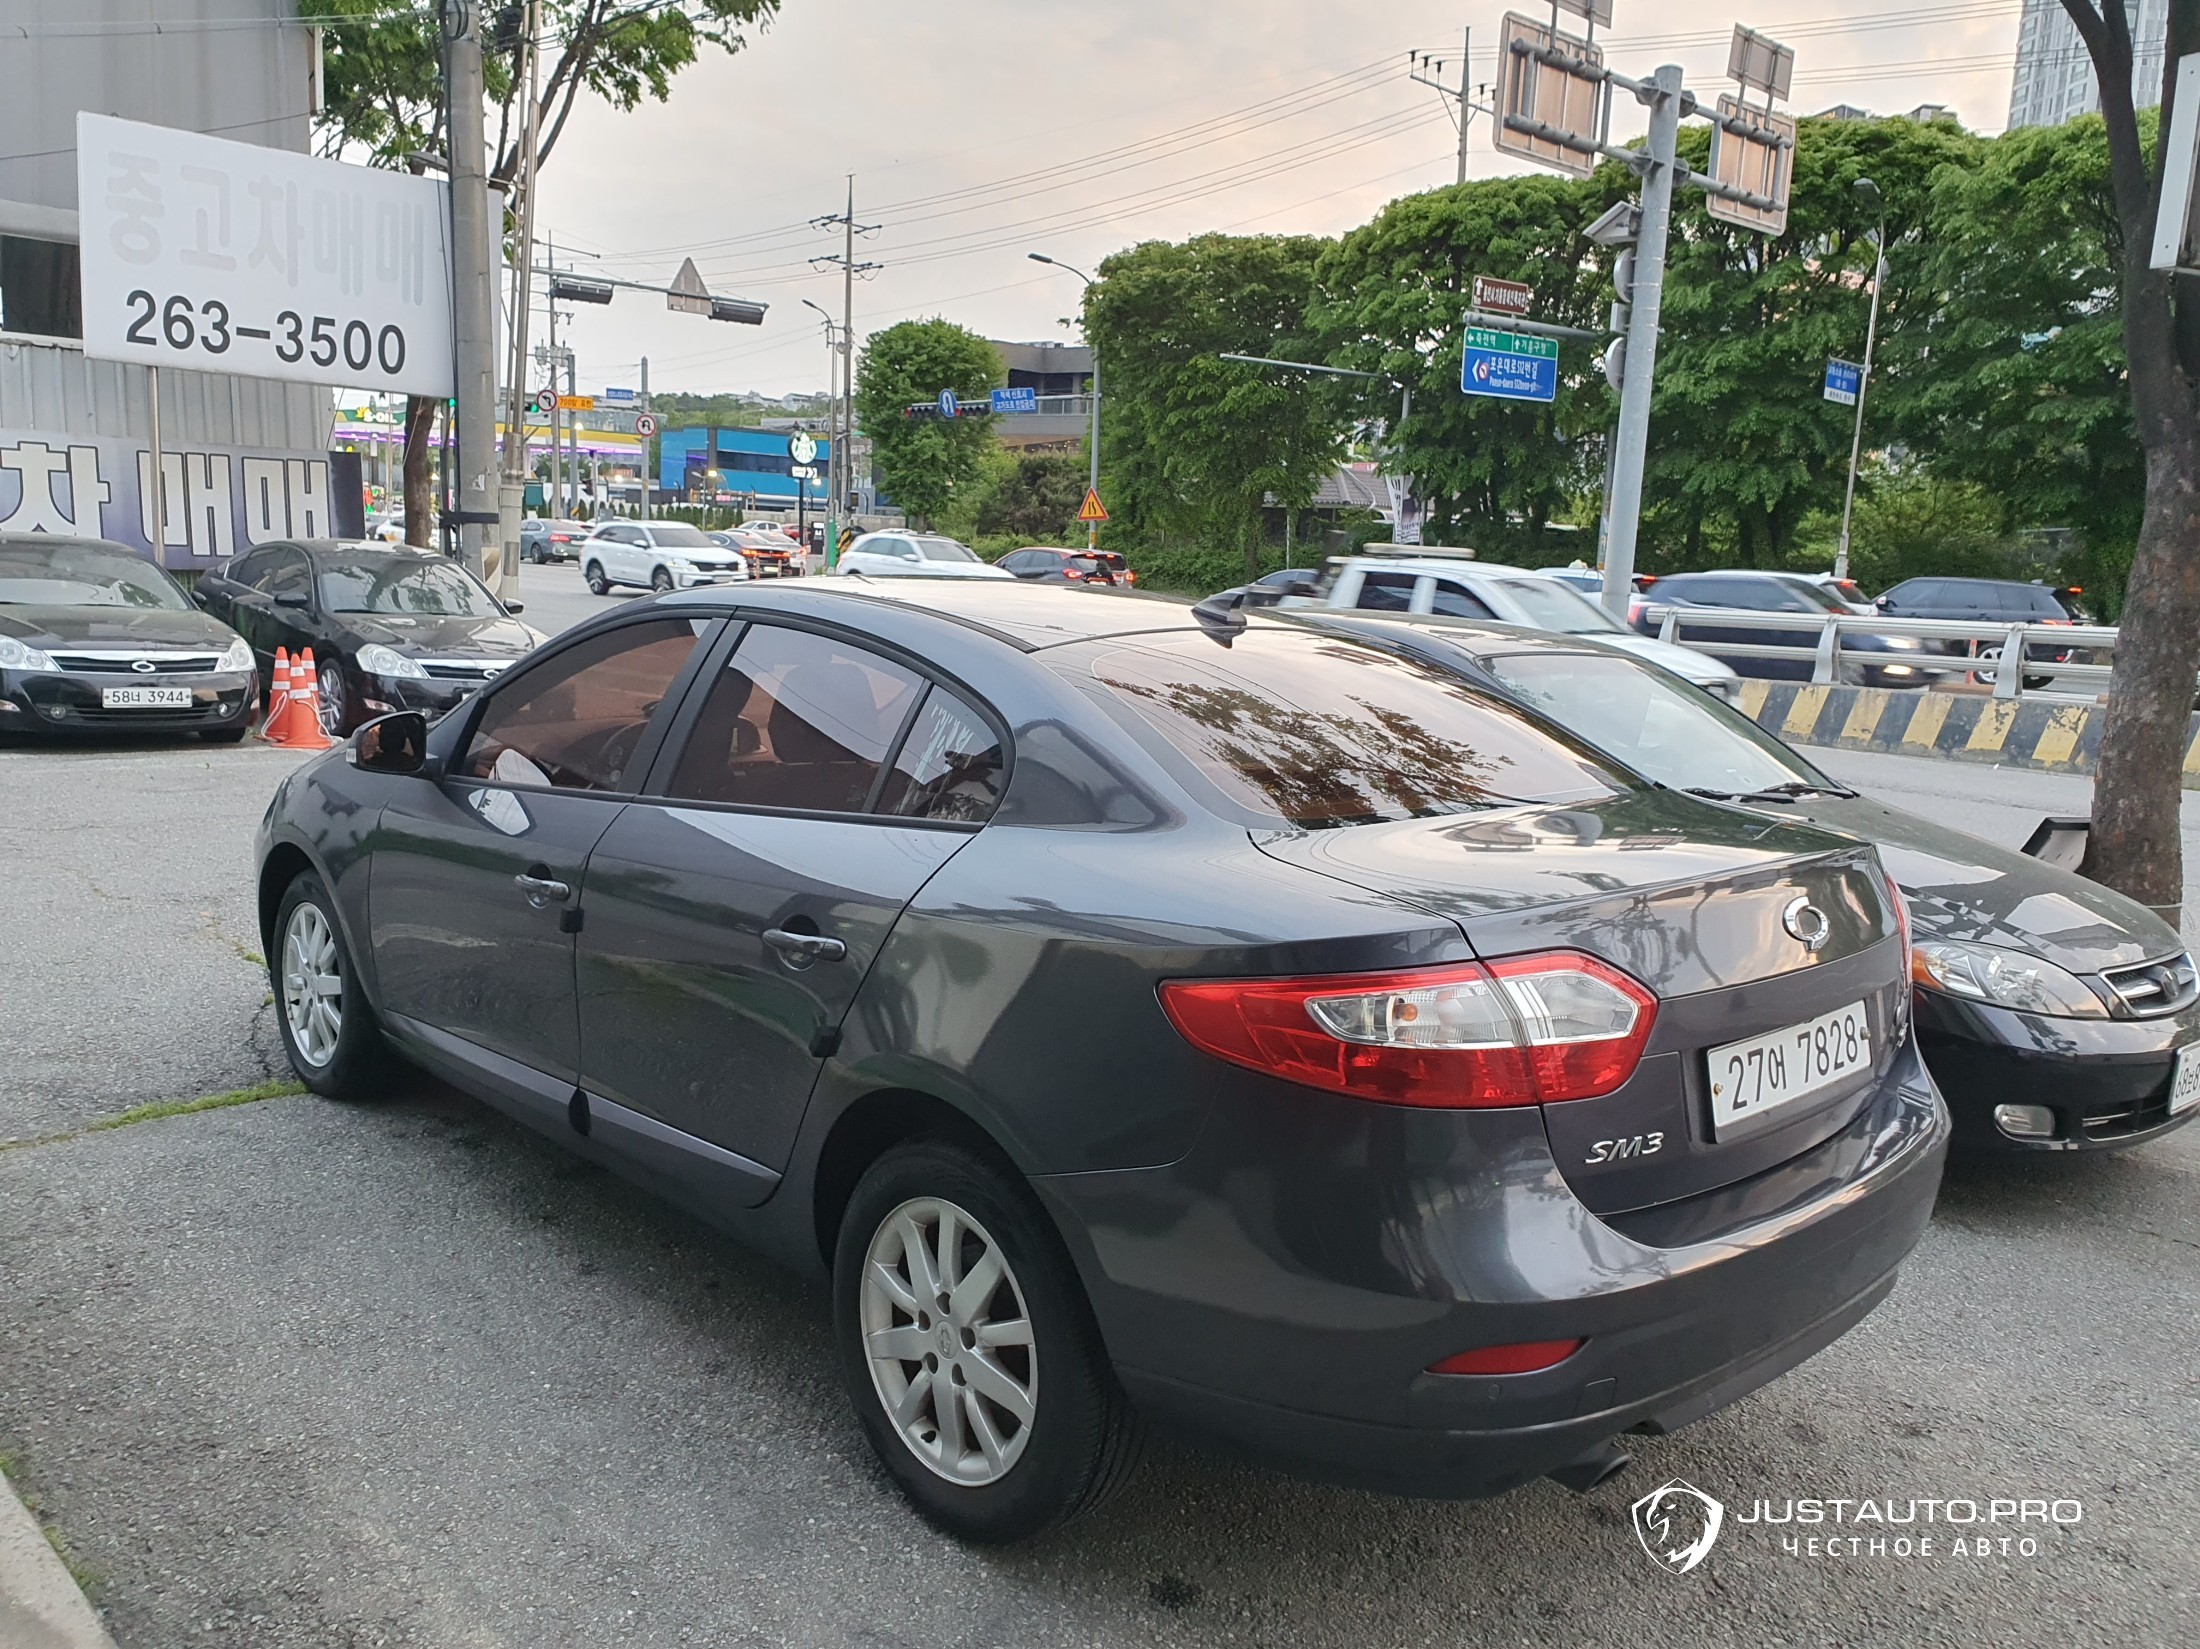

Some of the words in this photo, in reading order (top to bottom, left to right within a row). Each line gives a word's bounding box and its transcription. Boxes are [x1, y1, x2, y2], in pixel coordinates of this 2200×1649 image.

[105, 151, 424, 306] 중고차매매
[126, 290, 406, 374] 263-3500
[112, 690, 140, 703] 58너
[147, 690, 184, 703] 3944
[1728, 1044, 1787, 1111] 27어
[1797, 1014, 1858, 1084] 7828
[1585, 1132, 1664, 1164] SM3
